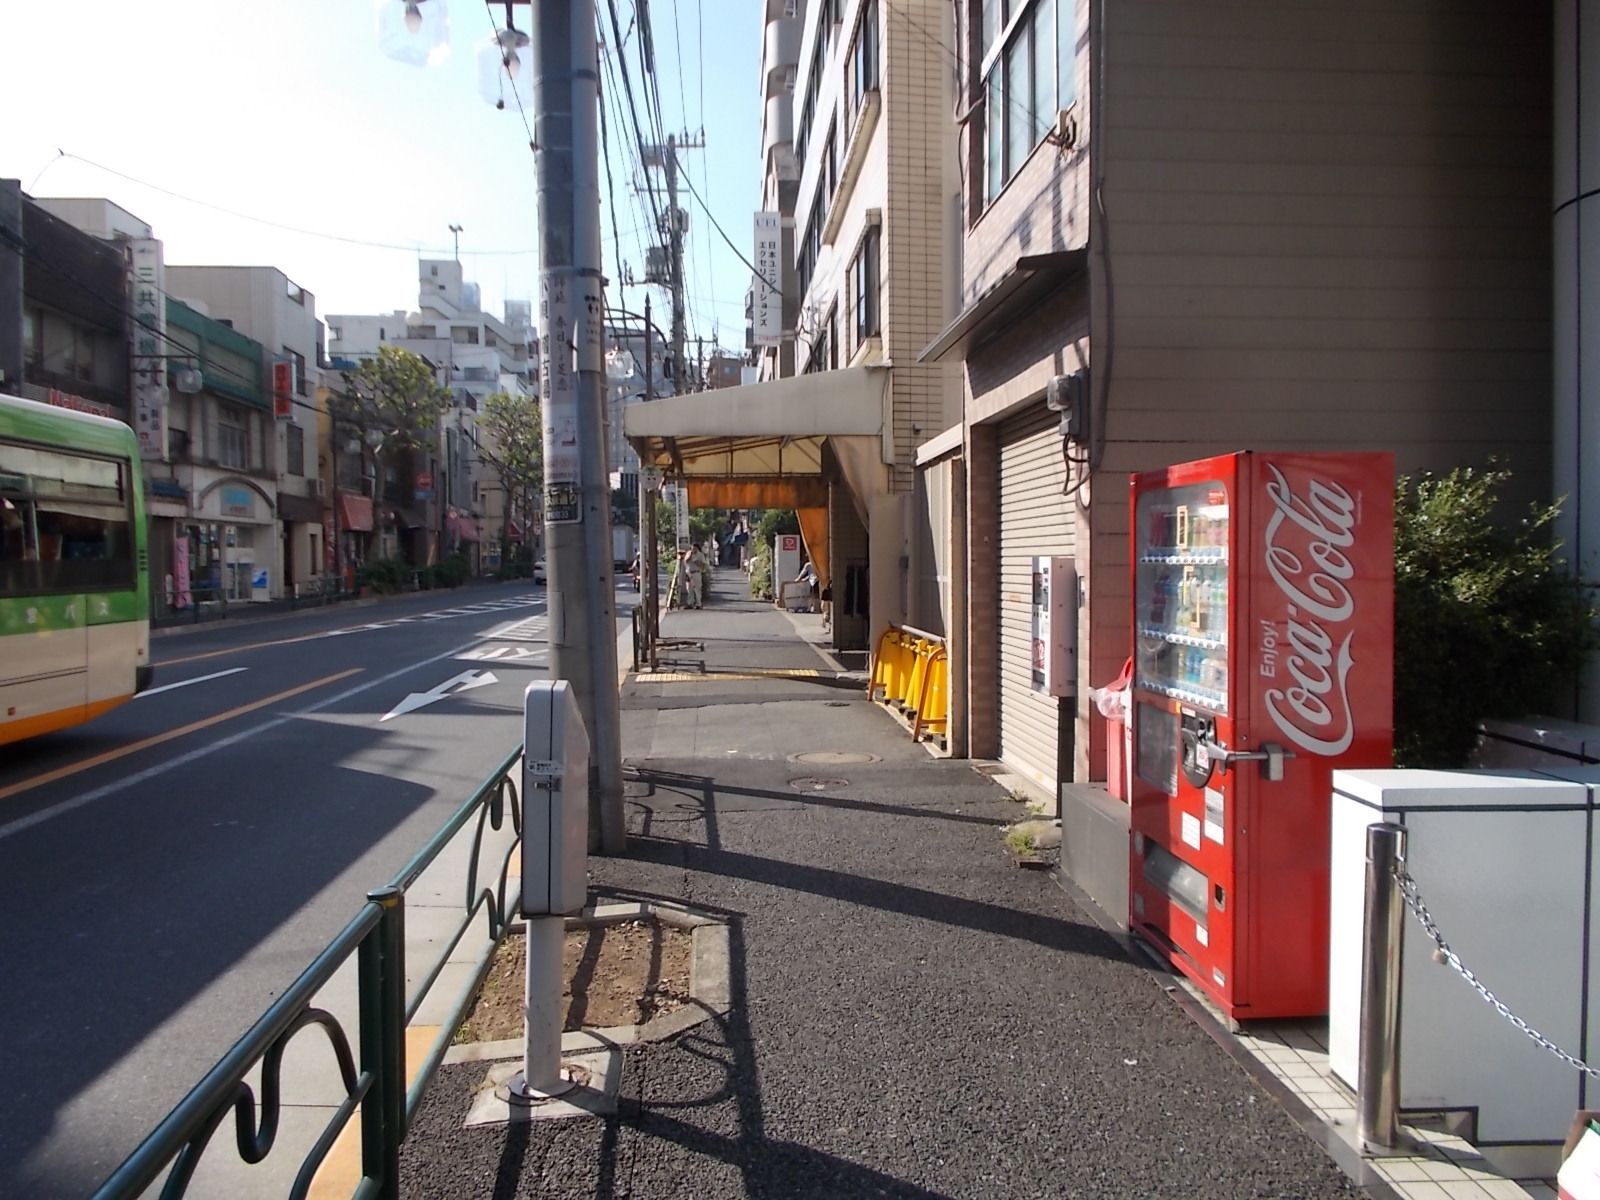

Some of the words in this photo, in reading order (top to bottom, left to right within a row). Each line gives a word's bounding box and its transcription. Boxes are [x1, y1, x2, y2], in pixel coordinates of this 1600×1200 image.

[759, 241, 768, 327] エクセリーションズ
[1260, 620, 1276, 679] Enjoy!
[1265, 462, 1355, 756] Coca-Cola
